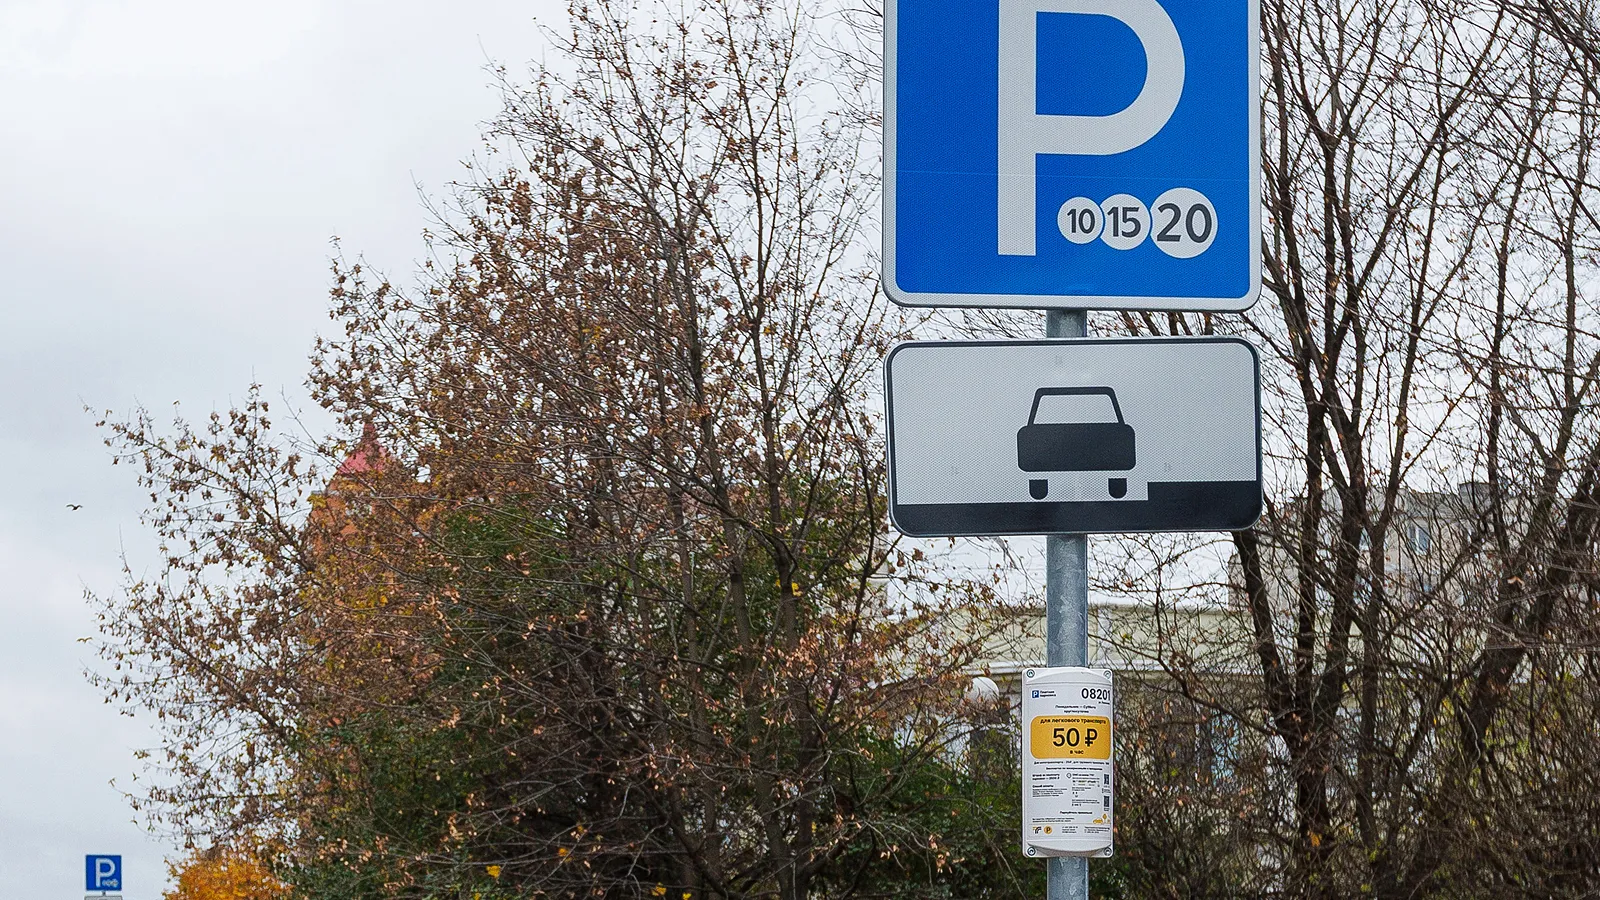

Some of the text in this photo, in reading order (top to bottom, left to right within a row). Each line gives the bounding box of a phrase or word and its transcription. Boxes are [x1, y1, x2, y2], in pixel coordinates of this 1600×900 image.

[998, 0, 1185, 256] P
[1067, 203, 1212, 243] 10 15 20
[1053, 728, 1080, 747] 50
[95, 858, 115, 887] P
